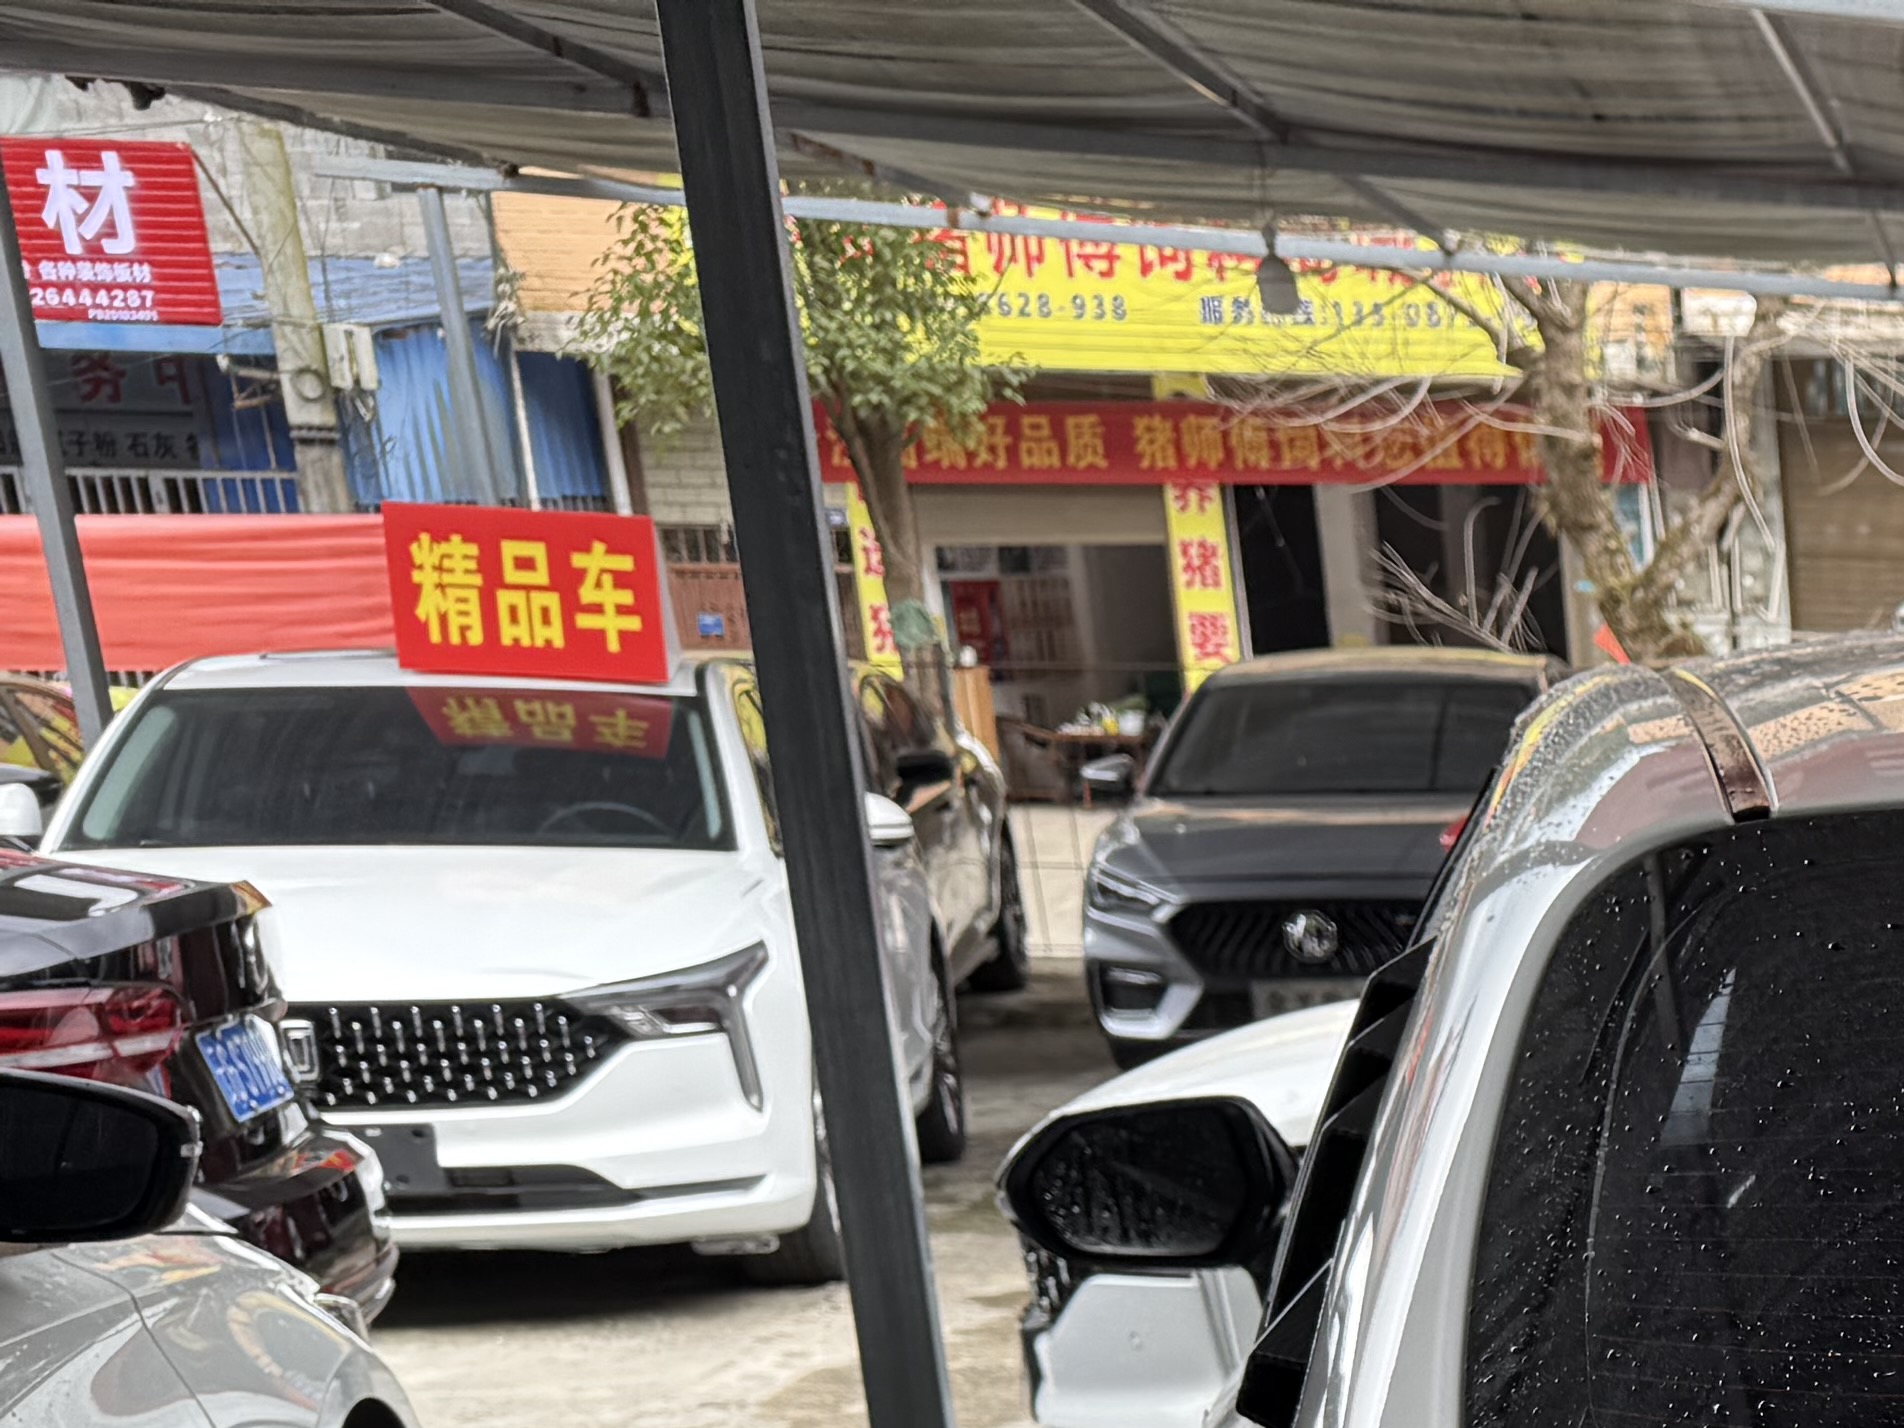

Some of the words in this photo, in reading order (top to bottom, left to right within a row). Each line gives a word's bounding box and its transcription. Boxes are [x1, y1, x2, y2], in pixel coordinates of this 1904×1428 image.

[35, 149, 136, 255] 材
[409, 531, 643, 654] 精品车
